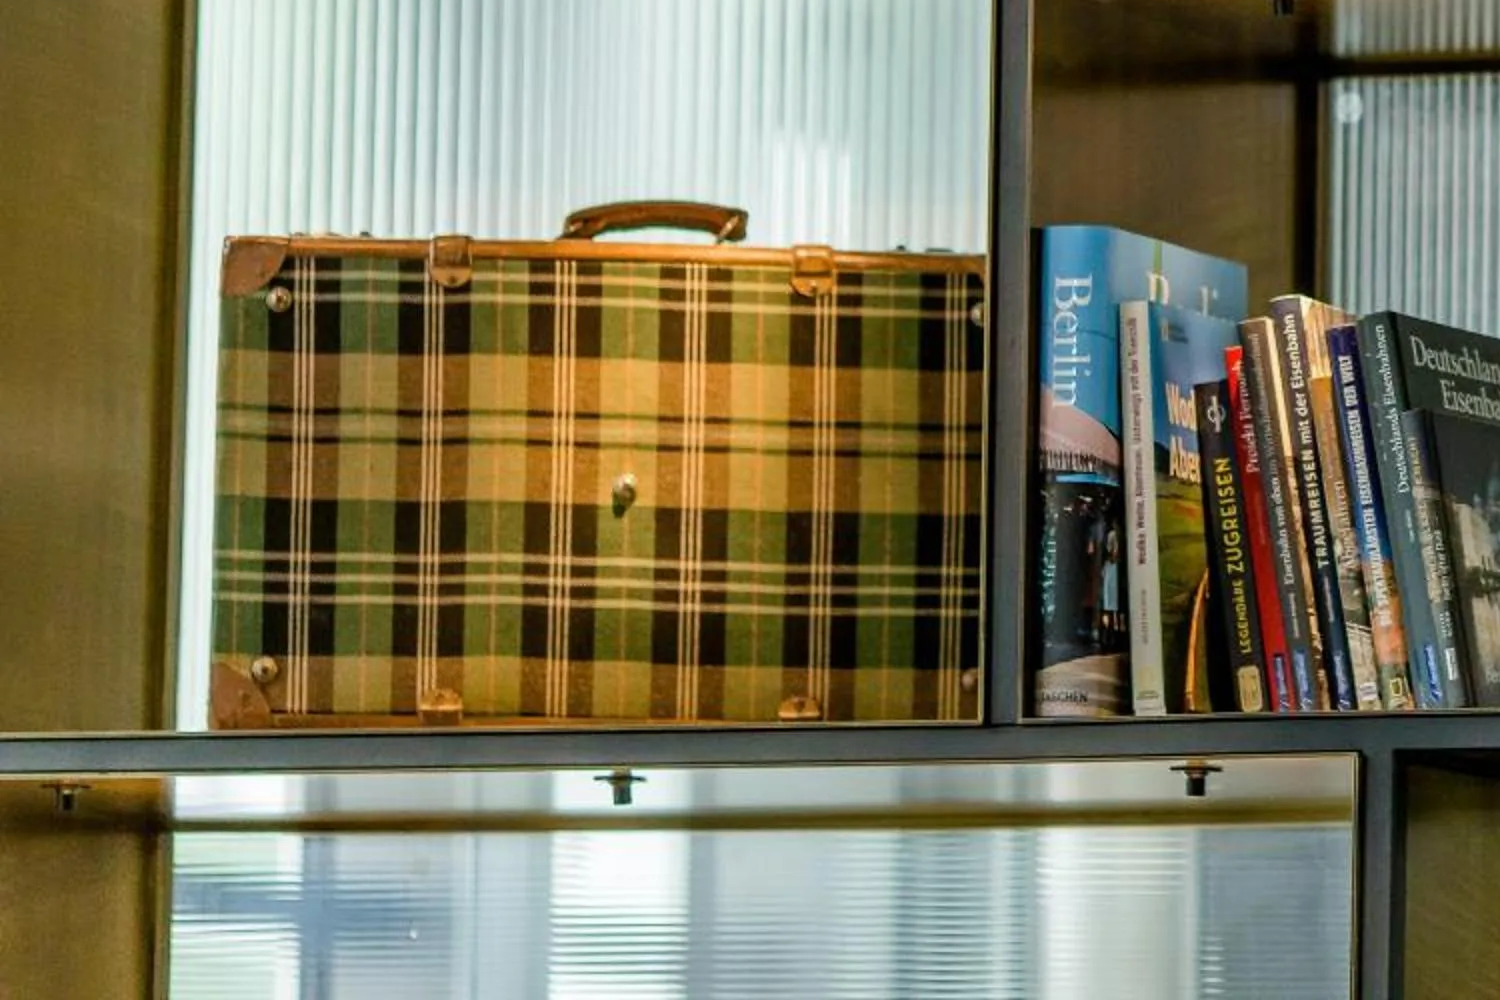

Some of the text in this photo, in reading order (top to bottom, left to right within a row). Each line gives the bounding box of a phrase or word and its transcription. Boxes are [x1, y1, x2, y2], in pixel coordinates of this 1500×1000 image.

[1052, 273, 1093, 408] Berlin
[1286, 313, 1305, 388] Eisenbahn
[1375, 324, 1396, 405] Eisenbahnen
[1166, 382, 1197, 431] Wod
[1295, 392, 1309, 417] der
[1299, 417, 1313, 445] mit
[1170, 435, 1202, 483] Abe
[1386, 406, 1409, 493] Deutschlands
[1214, 456, 1244, 573] ZUGREISEN
[1302, 448, 1329, 568] TRAUMREISEN
